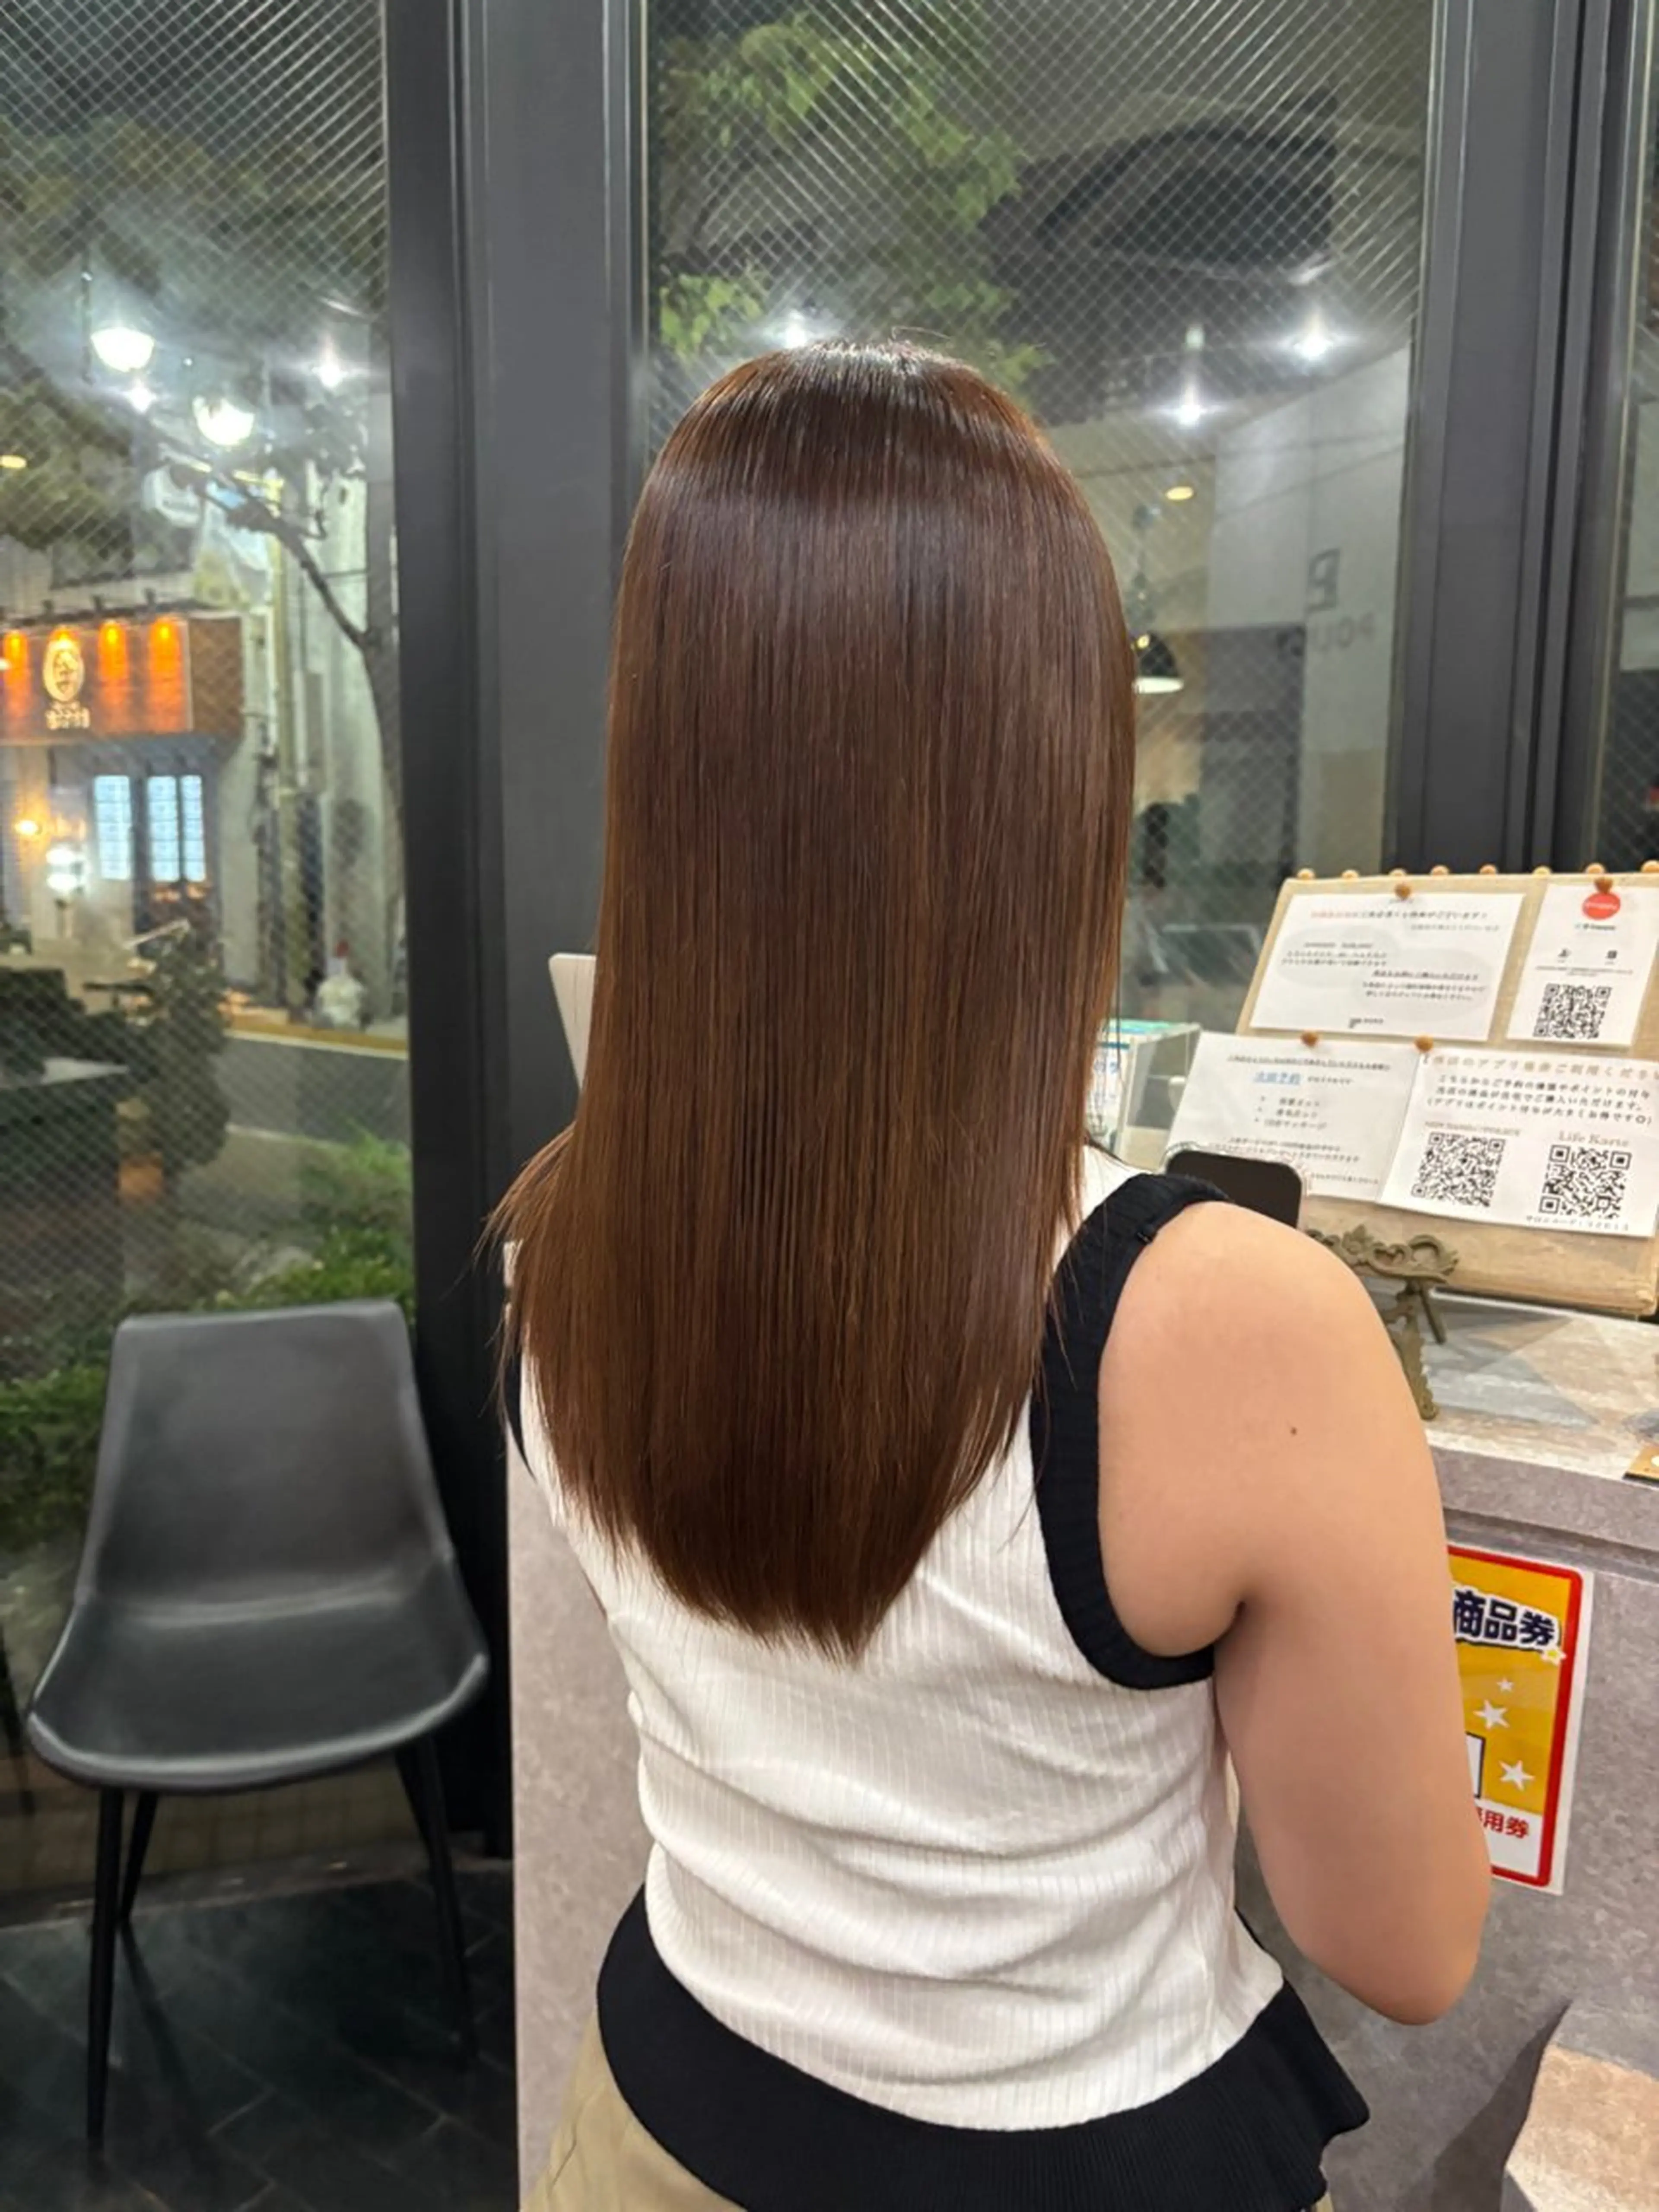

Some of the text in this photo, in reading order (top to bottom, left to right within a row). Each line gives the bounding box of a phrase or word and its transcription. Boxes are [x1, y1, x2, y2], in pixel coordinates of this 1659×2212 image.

[1454, 1589, 1555, 1646] 商品券
[1478, 1807, 1529, 1839] 用券
